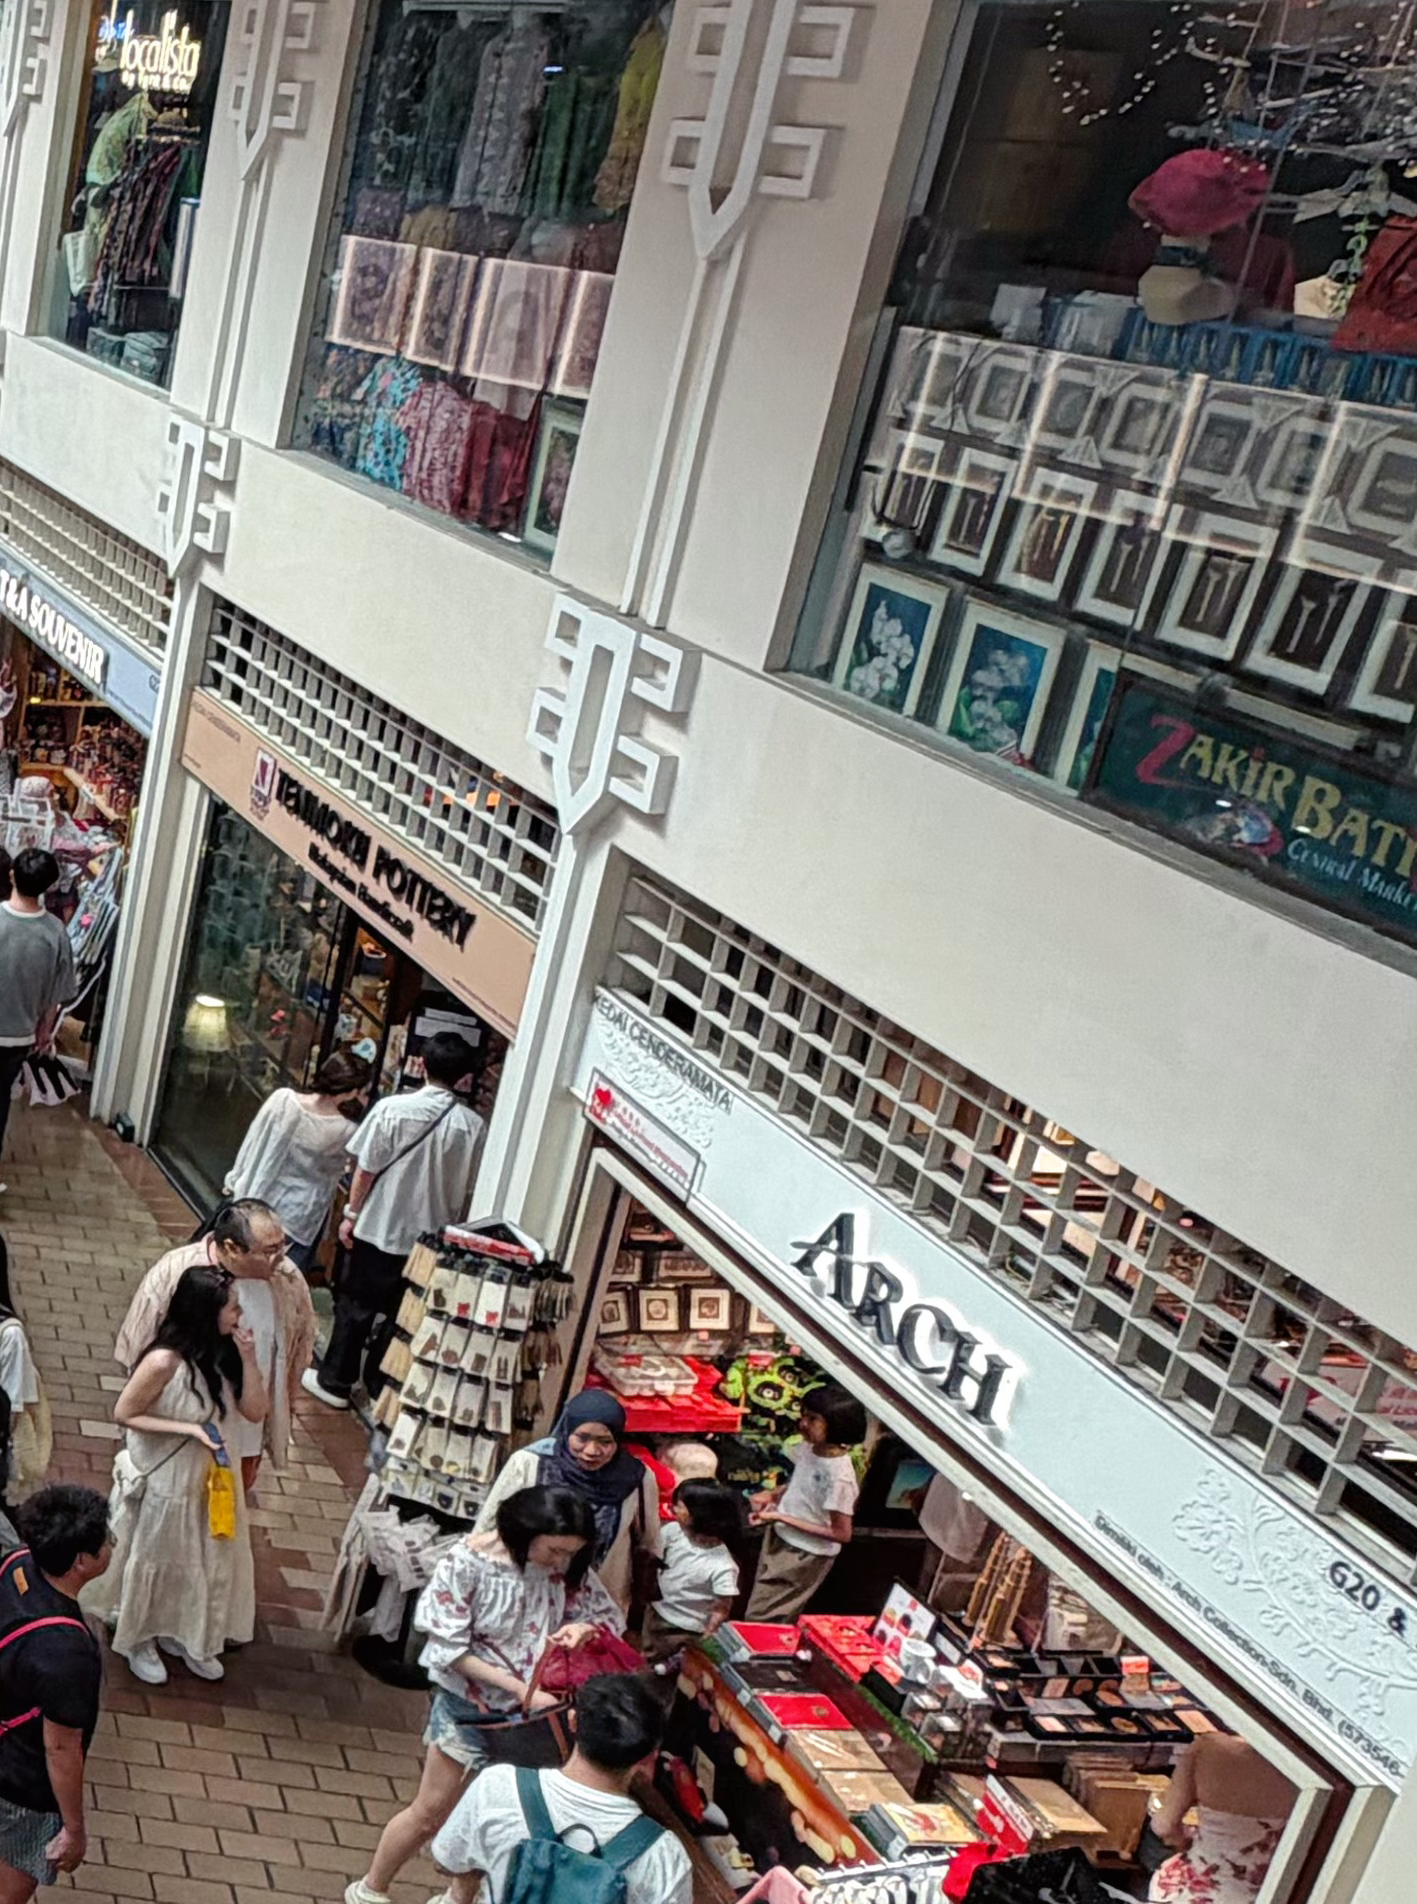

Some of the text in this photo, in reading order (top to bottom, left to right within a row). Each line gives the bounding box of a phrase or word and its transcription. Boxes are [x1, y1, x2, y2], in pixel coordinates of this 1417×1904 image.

[120, 8, 201, 78] localista
[28, 594, 104, 684] SOUVENIR
[789, 1210, 1017, 1427] ARCH
[1094, 1514, 1138, 1558] Dimiliki
[1172, 1581, 1202, 1612] Arch
[1329, 1560, 1382, 1612] G20
